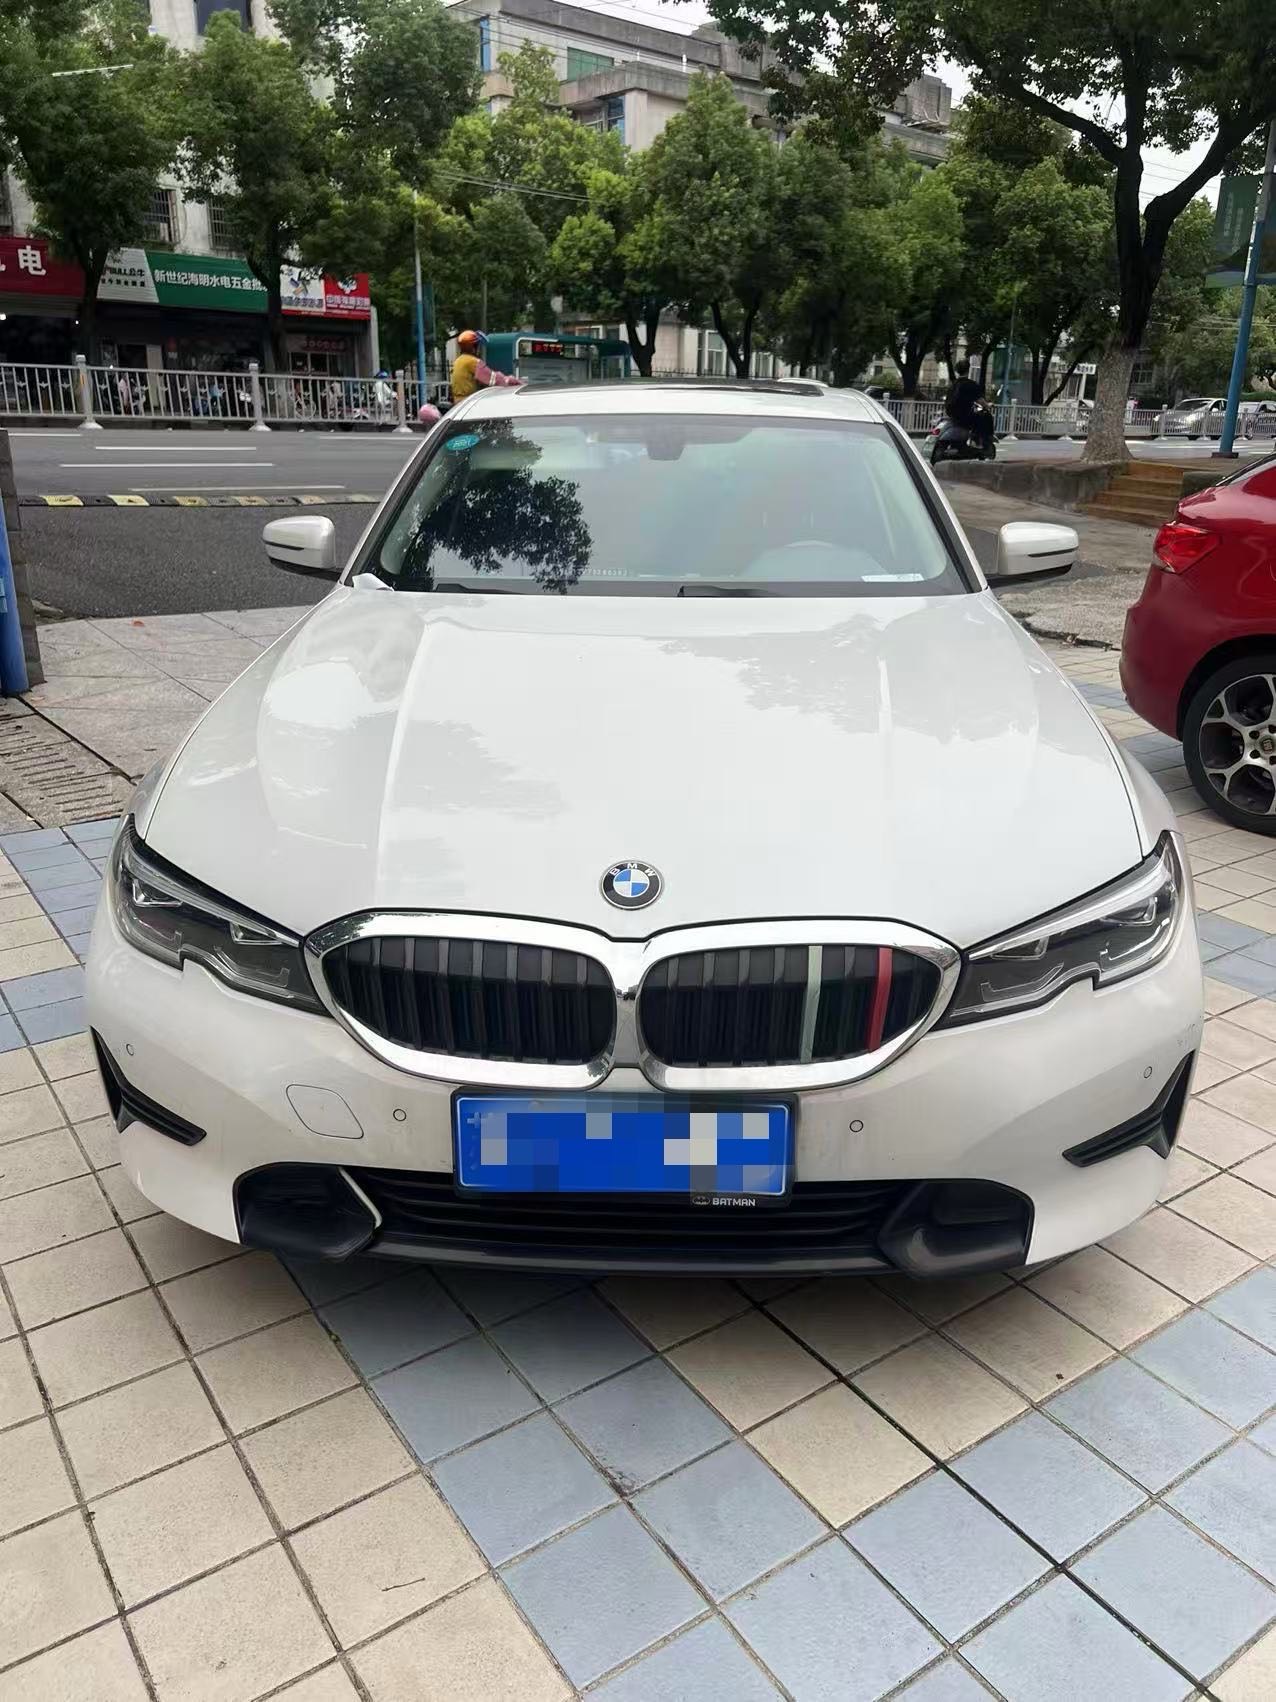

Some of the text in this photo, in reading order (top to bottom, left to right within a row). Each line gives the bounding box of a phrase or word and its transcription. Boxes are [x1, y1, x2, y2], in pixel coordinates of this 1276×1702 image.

[0, 245, 46, 276] 电
[154, 269, 268, 292] 新世纪海明水电五金批
[609, 863, 656, 877] BMW
[712, 1197, 756, 1206] BATMAN
